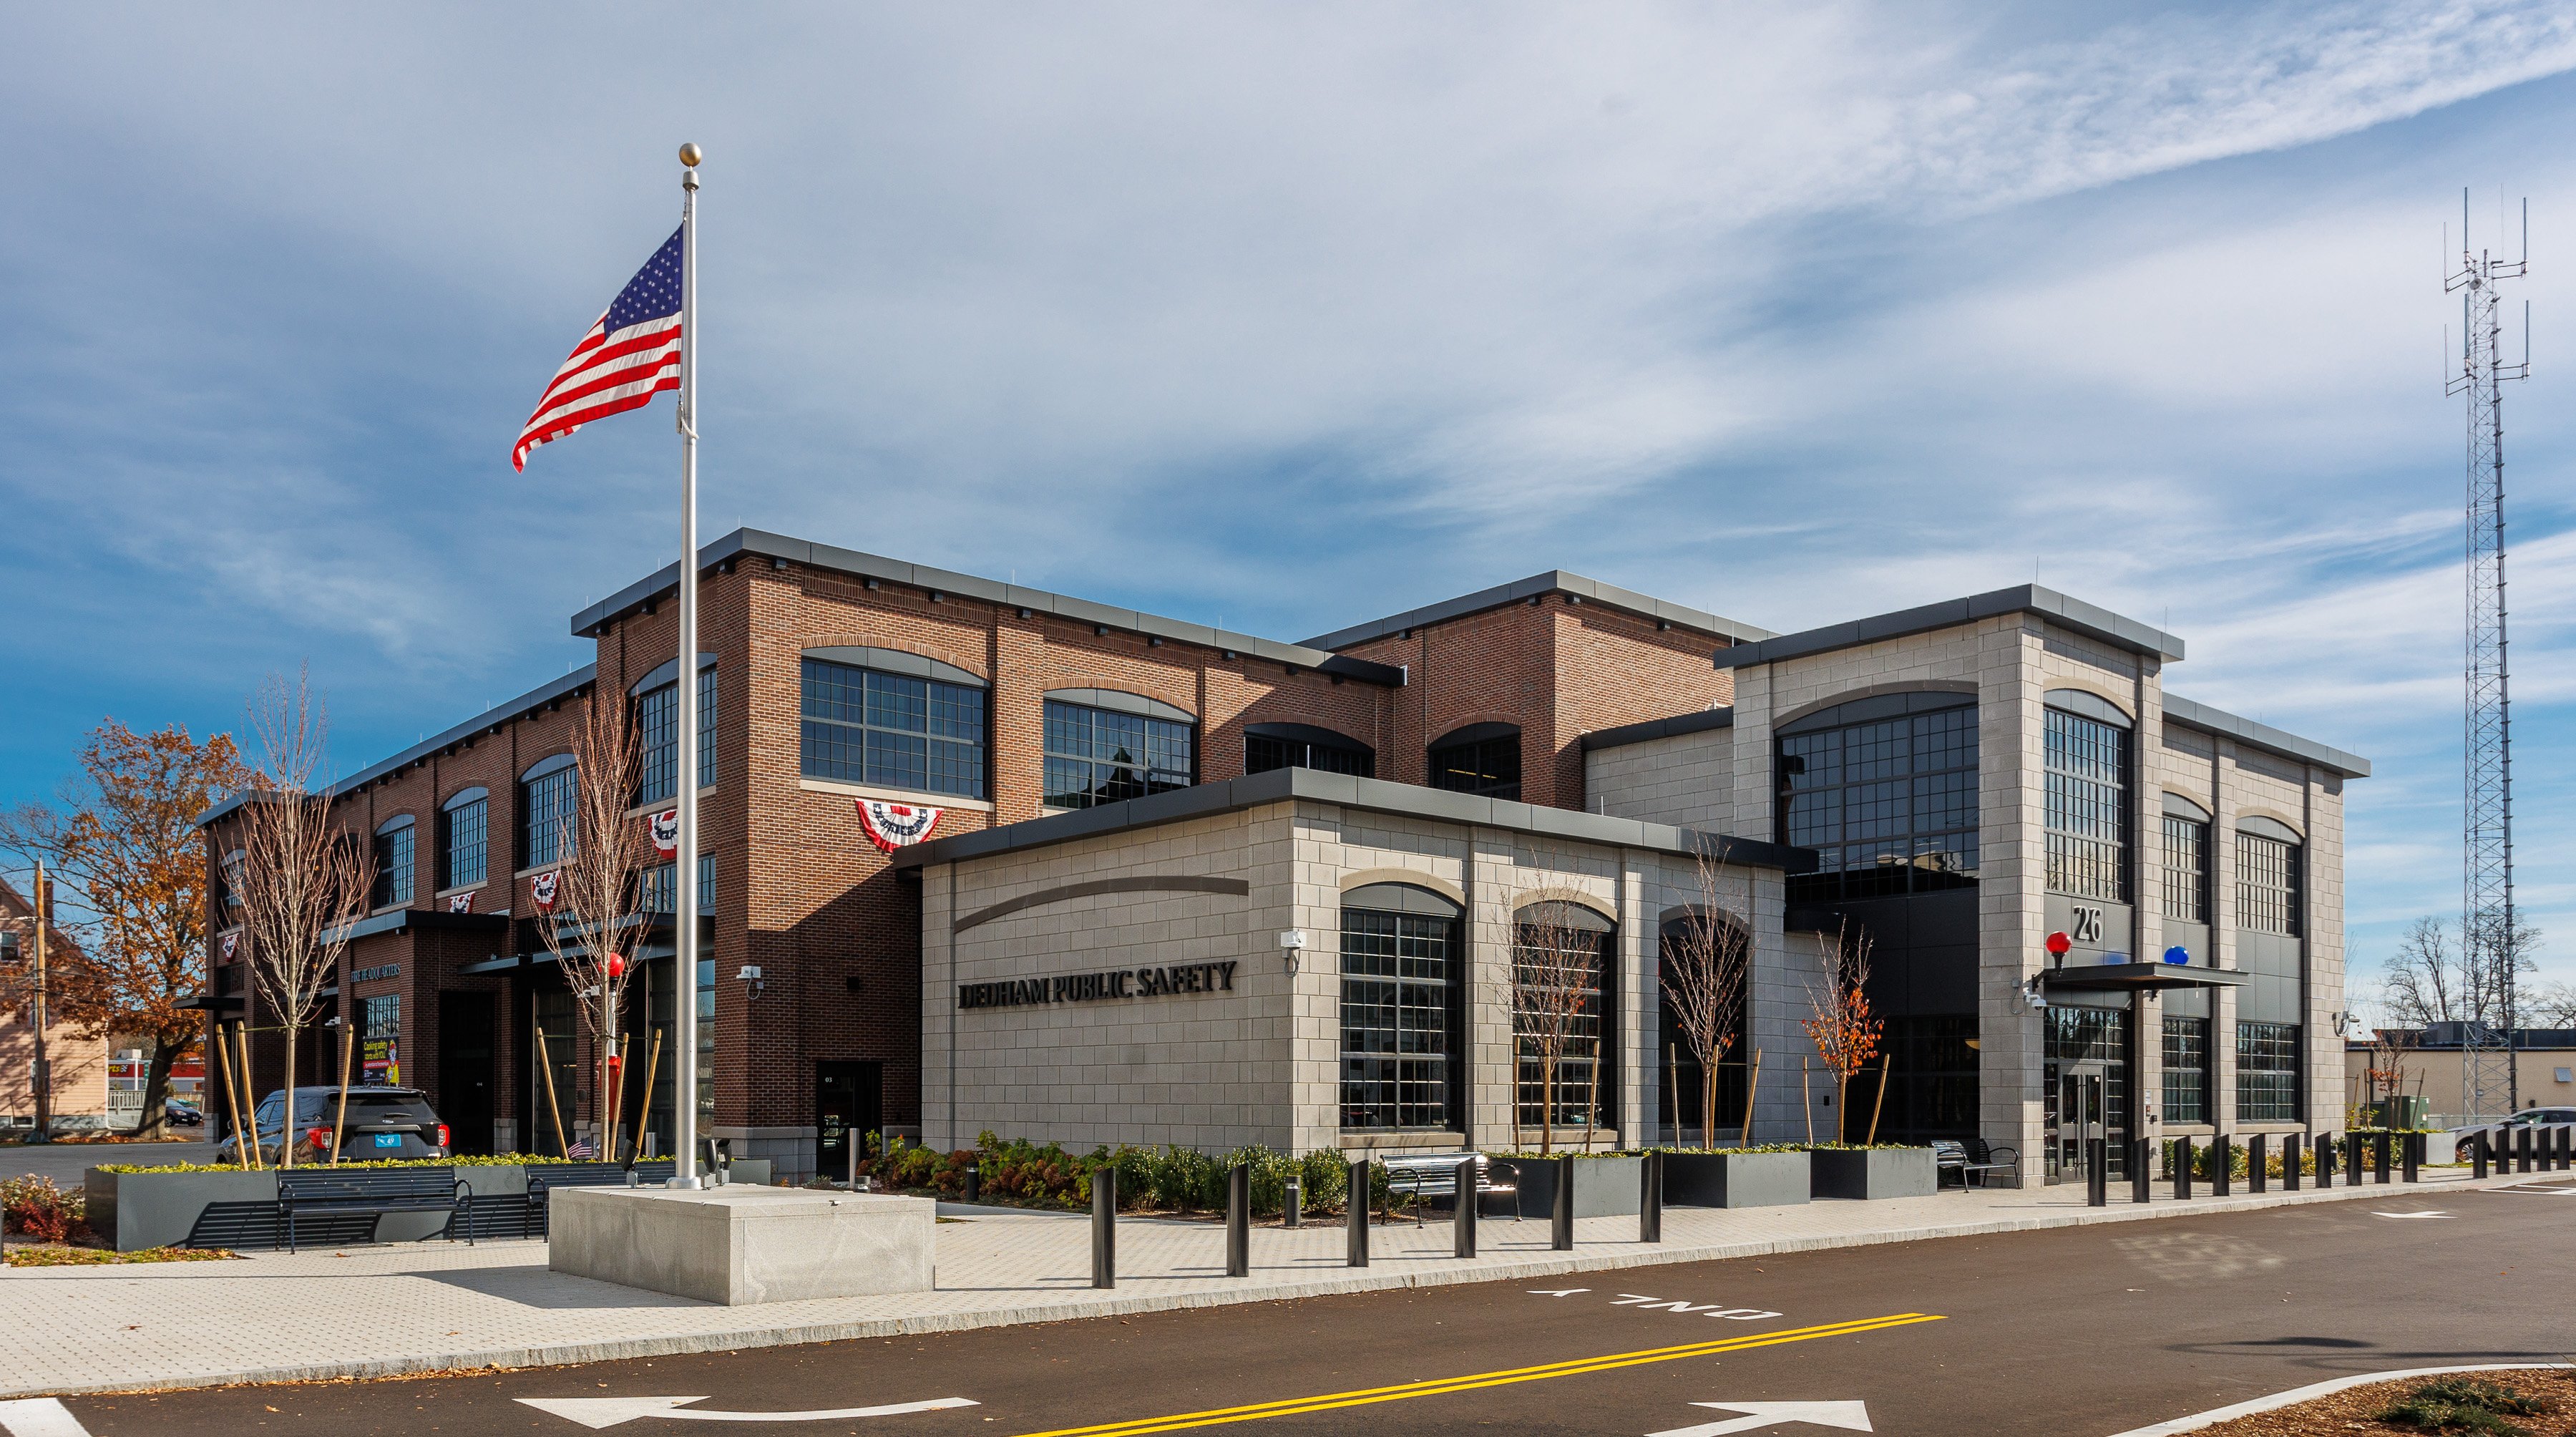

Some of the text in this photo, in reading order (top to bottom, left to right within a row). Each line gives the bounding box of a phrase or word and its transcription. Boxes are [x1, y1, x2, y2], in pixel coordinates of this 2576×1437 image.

[2074, 905, 2102, 942] 26
[351, 963, 400, 983] FIRE HEADQUARTERS
[958, 961, 1237, 1009] DEDHAM PUBLIC SAFETY
[378, 1040, 387, 1051] safety
[107, 1064, 120, 1073] rts
[1526, 1288, 1784, 1320] ONLY
